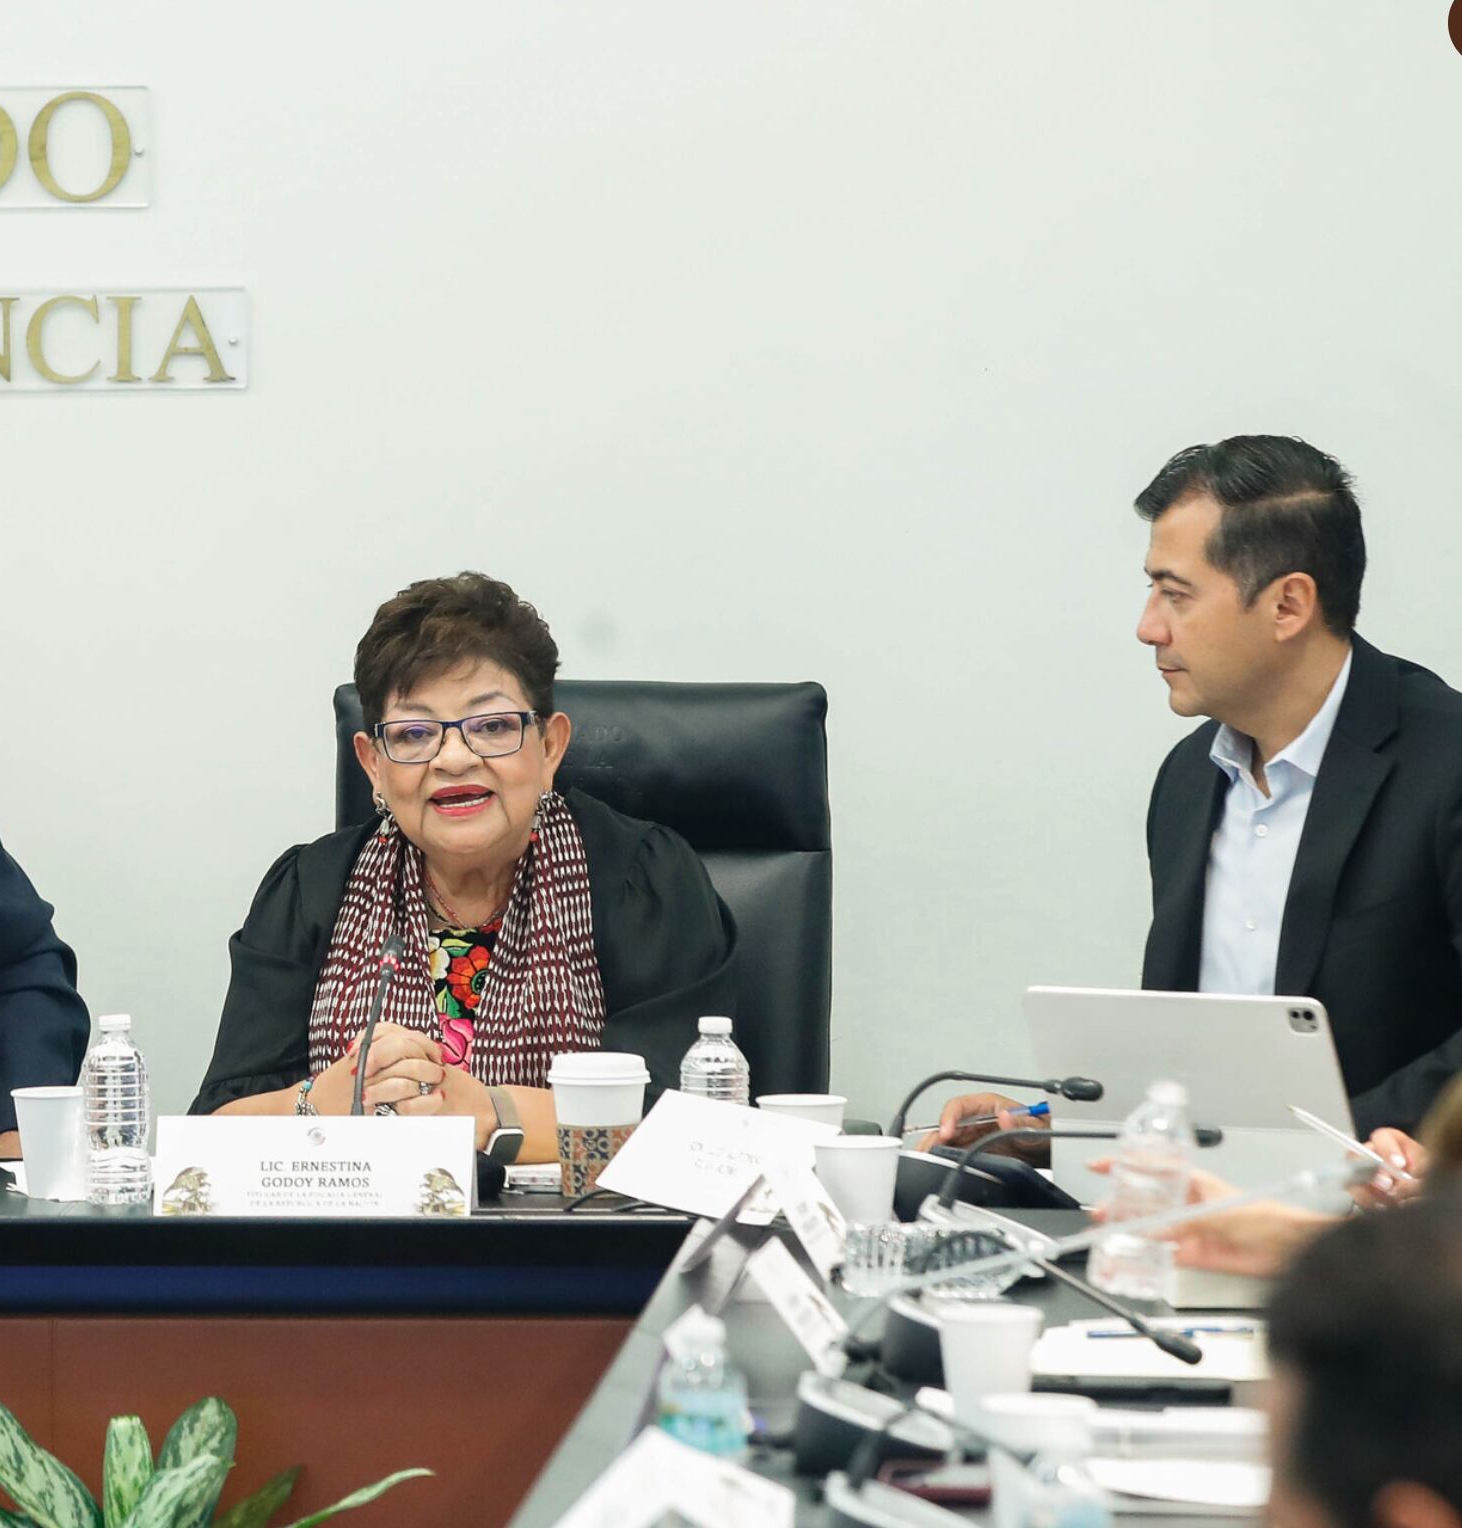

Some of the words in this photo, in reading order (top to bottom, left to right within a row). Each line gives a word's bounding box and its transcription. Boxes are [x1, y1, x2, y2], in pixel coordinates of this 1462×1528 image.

[292, 1161, 372, 1172] ERNESTINA
[261, 1177, 313, 1188] GODOY
[318, 1177, 370, 1188] RAMOS
